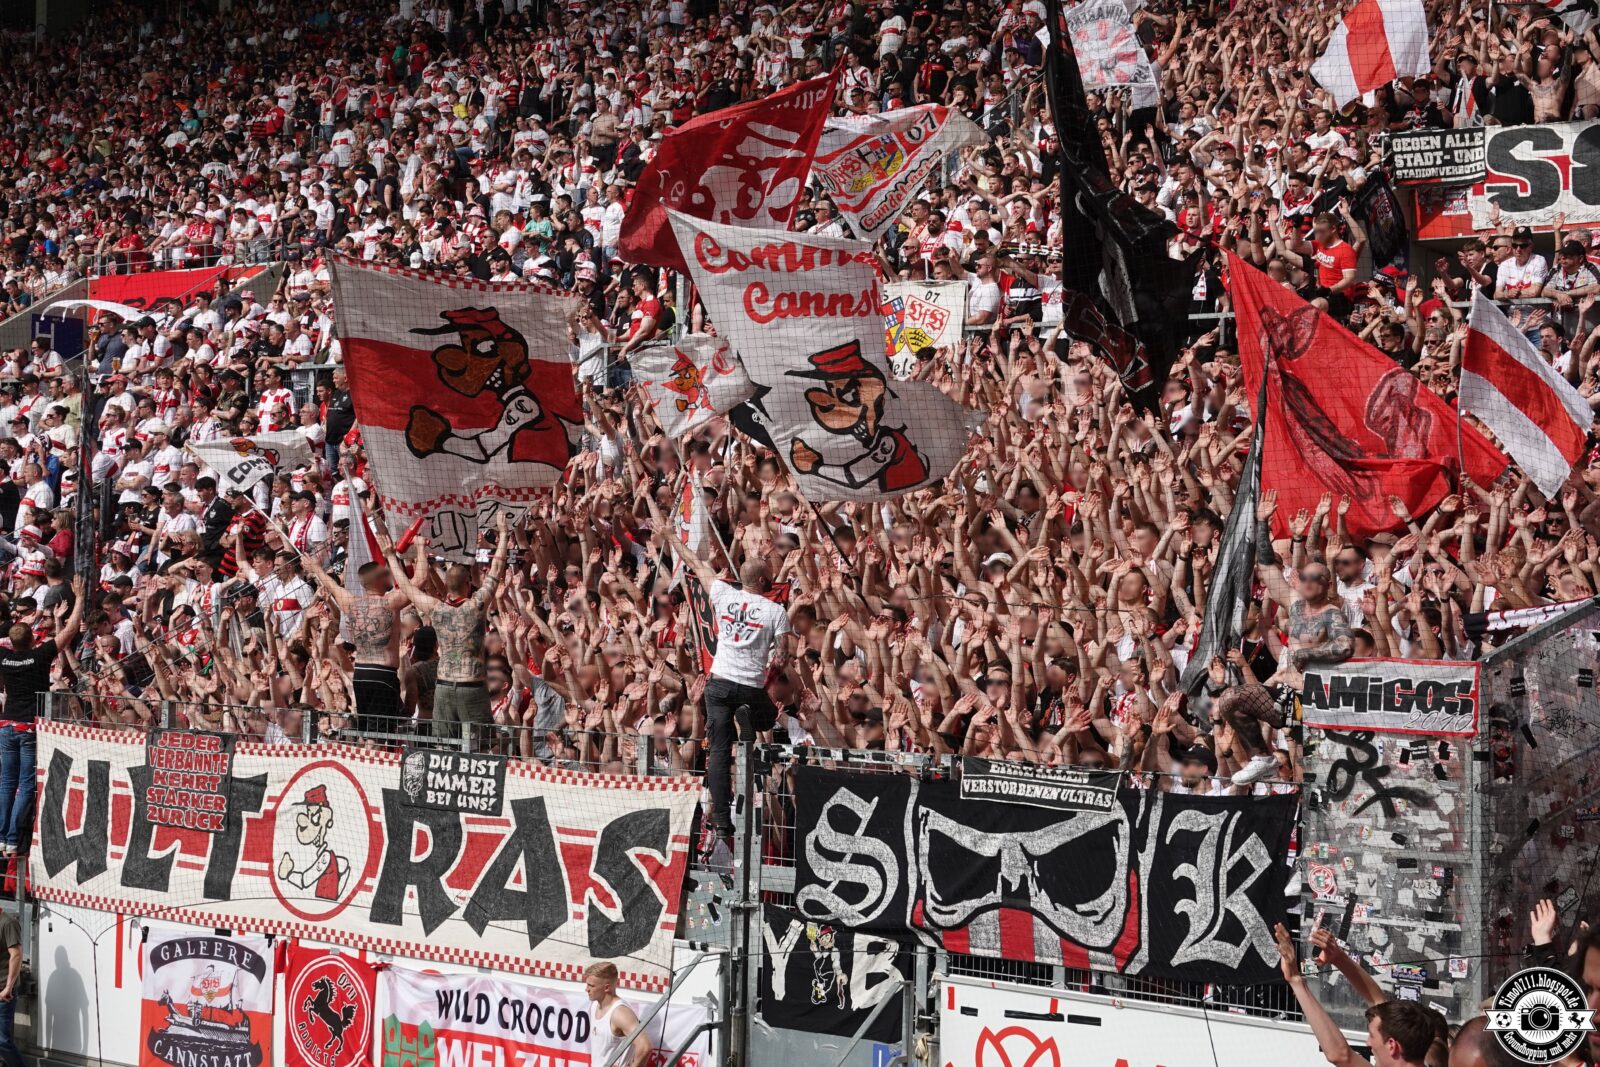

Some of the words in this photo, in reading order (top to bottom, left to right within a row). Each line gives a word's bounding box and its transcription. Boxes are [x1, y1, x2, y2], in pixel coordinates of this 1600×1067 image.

[905, 111, 937, 142] 07
[1392, 136, 1441, 152] GEGEN
[1445, 132, 1484, 148] ALLE
[1394, 152, 1451, 169] STADT-
[1454, 147, 1485, 164] UND
[925, 290, 941, 303] 07
[1403, 710, 1474, 731] 2010
[157, 731, 222, 752] JEDER
[148, 745, 230, 775] VERBANNTE
[428, 754, 453, 772] DU
[458, 758, 500, 776] BIST
[153, 769, 221, 792] KEHRT
[426, 771, 497, 796] IMMER
[426, 790, 452, 806] BEI
[457, 794, 498, 812] UNS!
[963, 779, 1061, 801] VERSTORBENEN
[1059, 786, 1113, 808] ULTRAS
[796, 786, 900, 928] S
[160, 940, 253, 970] GALEERE
[435, 988, 491, 1025] WILD
[153, 1040, 253, 1067] CANNSTATT
